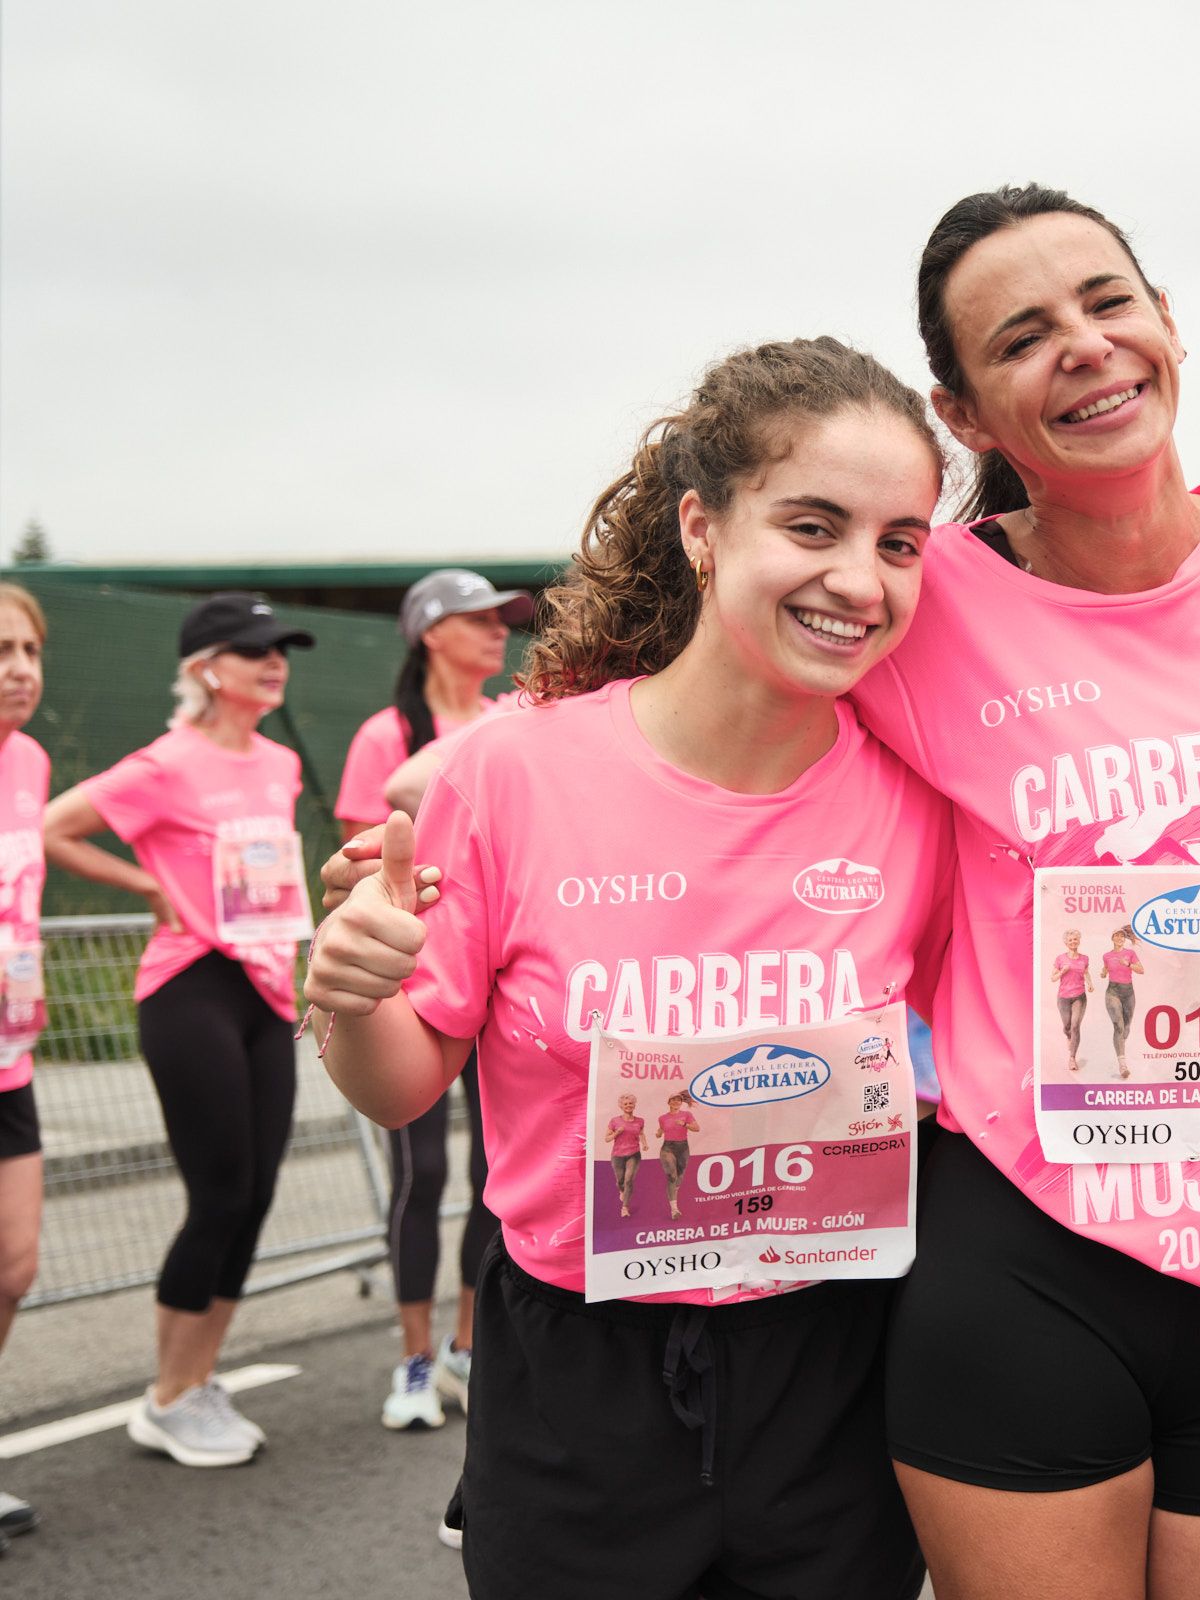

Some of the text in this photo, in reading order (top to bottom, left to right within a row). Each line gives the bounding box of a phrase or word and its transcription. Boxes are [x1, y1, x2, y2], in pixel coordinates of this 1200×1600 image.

[980, 680, 1101, 728] OYSHO
[557, 871, 687, 906] OYSHO
[1061, 885, 1125, 895] TU DORSAL
[1064, 896, 1126, 914] SUMA
[563, 949, 865, 1042] CARRERA
[619, 1050, 684, 1064] TU DORSAL
[620, 1062, 685, 1080] SUMA
[723, 1061, 816, 1078] CENTRAL LECHERA
[700, 1070, 820, 1098] ASTURIANA
[1084, 1089, 1154, 1106] CARRERA
[1159, 1089, 1178, 1104] DE
[848, 1119, 884, 1136] gijón
[1073, 1123, 1172, 1145] OYSHO
[822, 1138, 905, 1156] CORREDORA
[697, 1144, 814, 1194] 016
[694, 1193, 730, 1203] TELÉFONO
[731, 1186, 766, 1198] VIOLENCIA
[734, 1195, 773, 1215] 159
[635, 1211, 865, 1245] CARRERA DE LA MUJER GIJÓN
[785, 1246, 878, 1265] Santander
[624, 1251, 721, 1280] OYSHO
